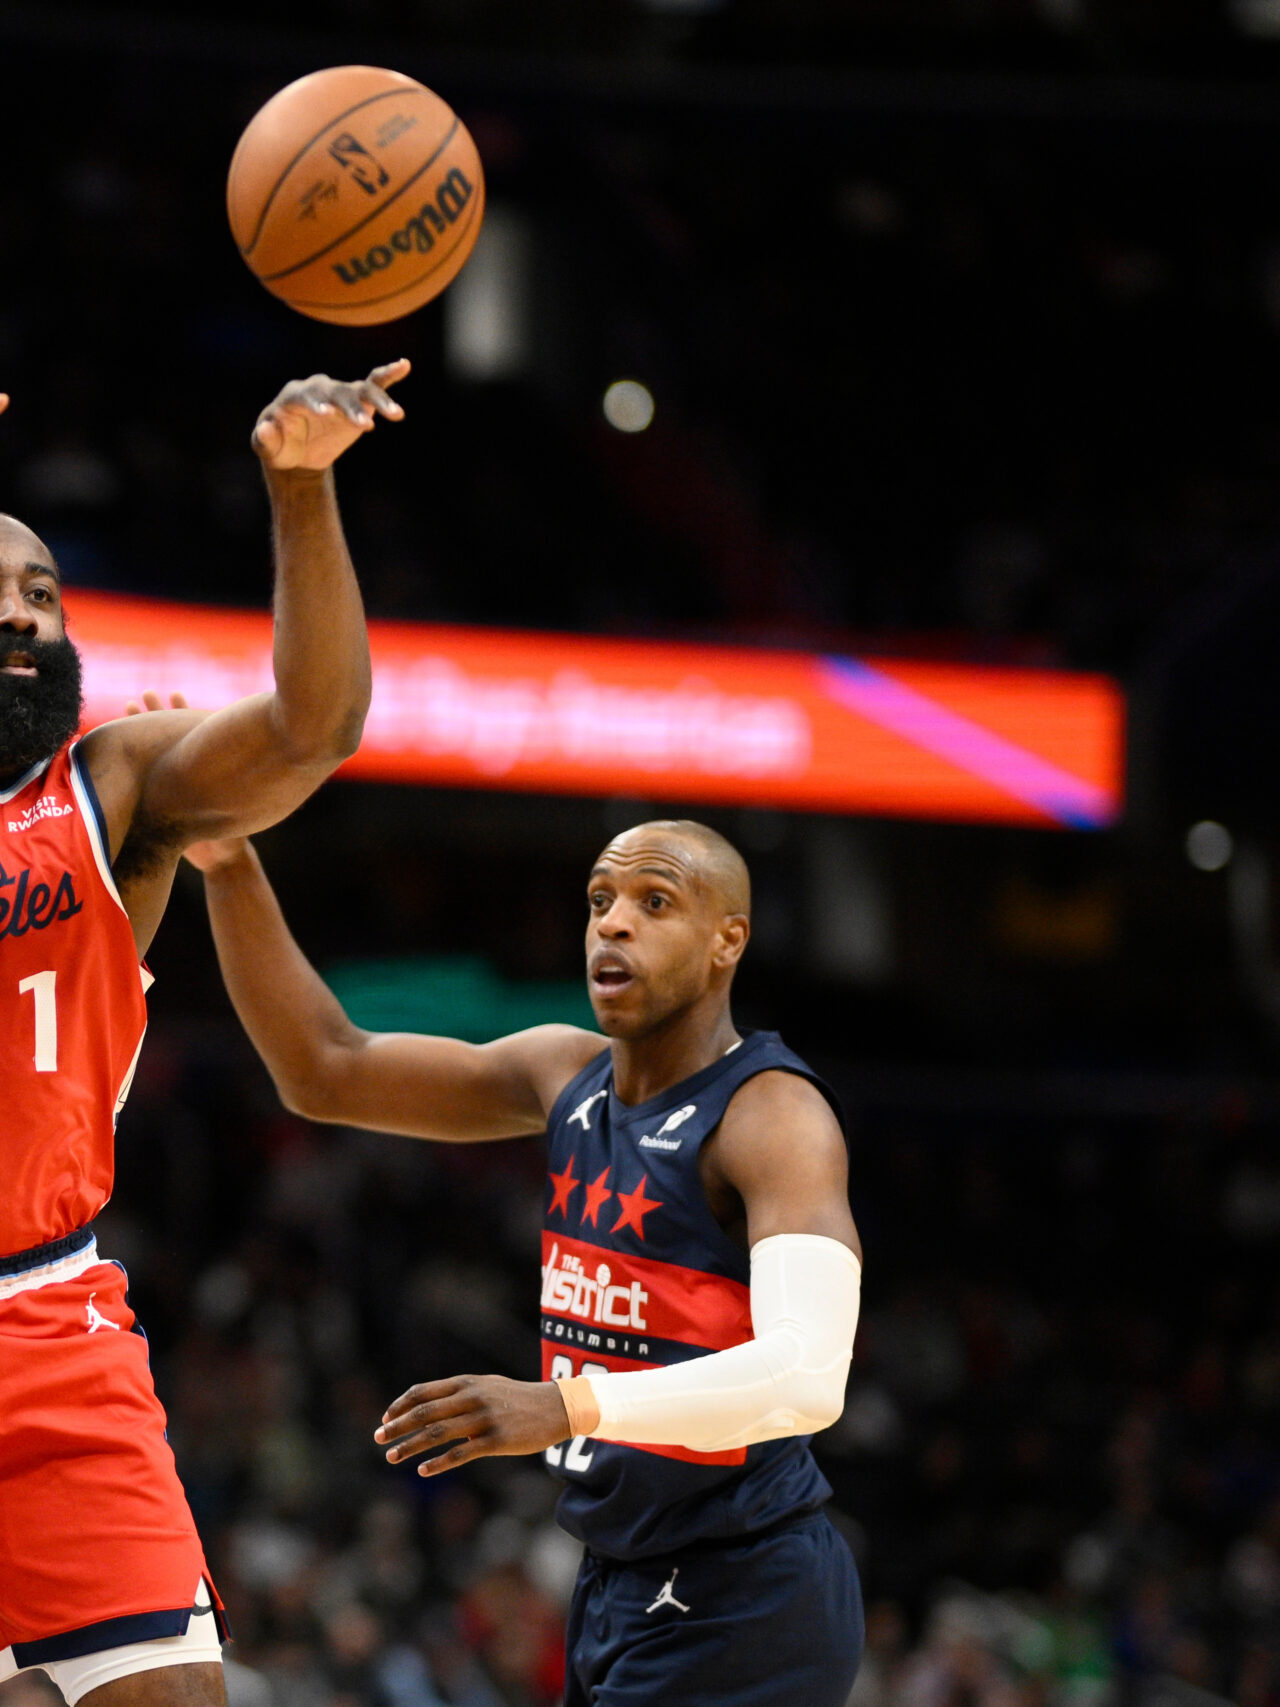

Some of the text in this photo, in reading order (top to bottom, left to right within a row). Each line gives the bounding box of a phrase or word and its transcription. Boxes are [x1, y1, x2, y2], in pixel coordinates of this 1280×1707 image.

[331, 167, 472, 284] Wilson
[8, 804, 74, 832] RWANDA
[21, 796, 56, 818] VISIT
[19, 970, 57, 1072] 1
[562, 1254, 581, 1272] THE
[544, 1321, 649, 1355] COLUMBIA
